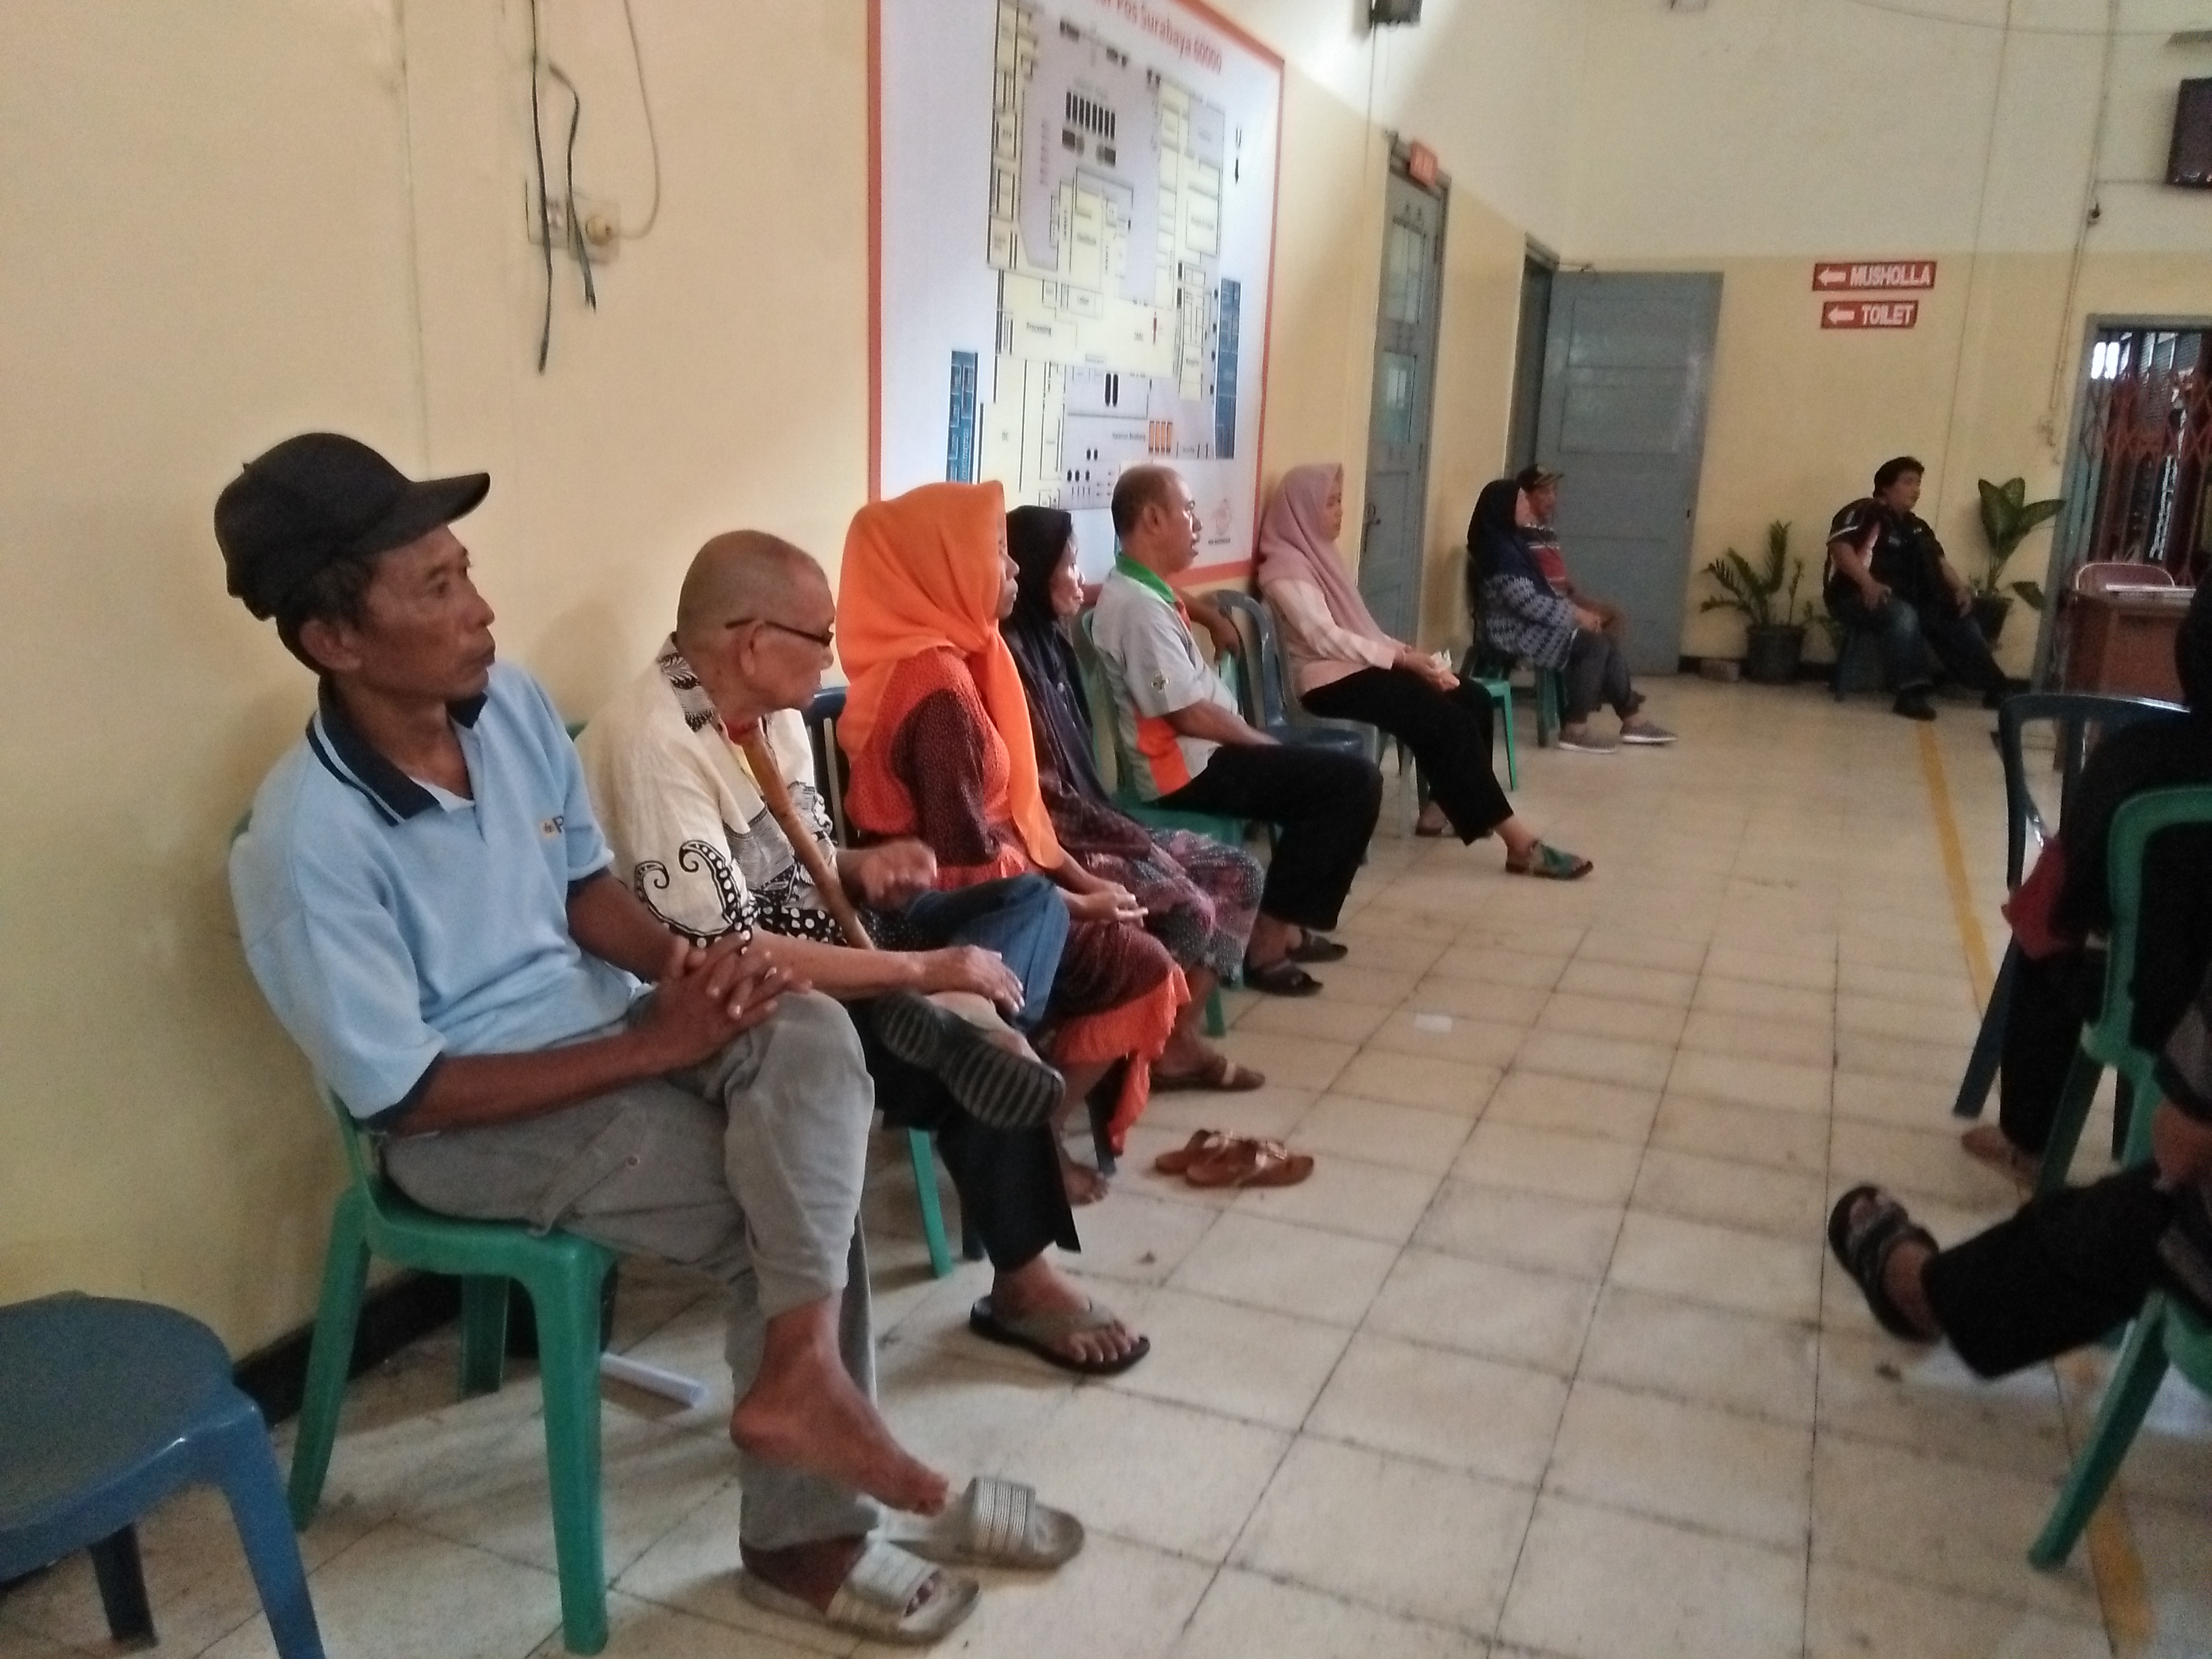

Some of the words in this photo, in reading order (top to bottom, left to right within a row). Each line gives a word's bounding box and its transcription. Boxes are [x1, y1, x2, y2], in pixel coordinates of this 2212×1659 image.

[1141, 2, 1191, 58] Surabaya
[1849, 264, 1931, 286] MUSHOLLA
[1861, 304, 1915, 325] TOILET
